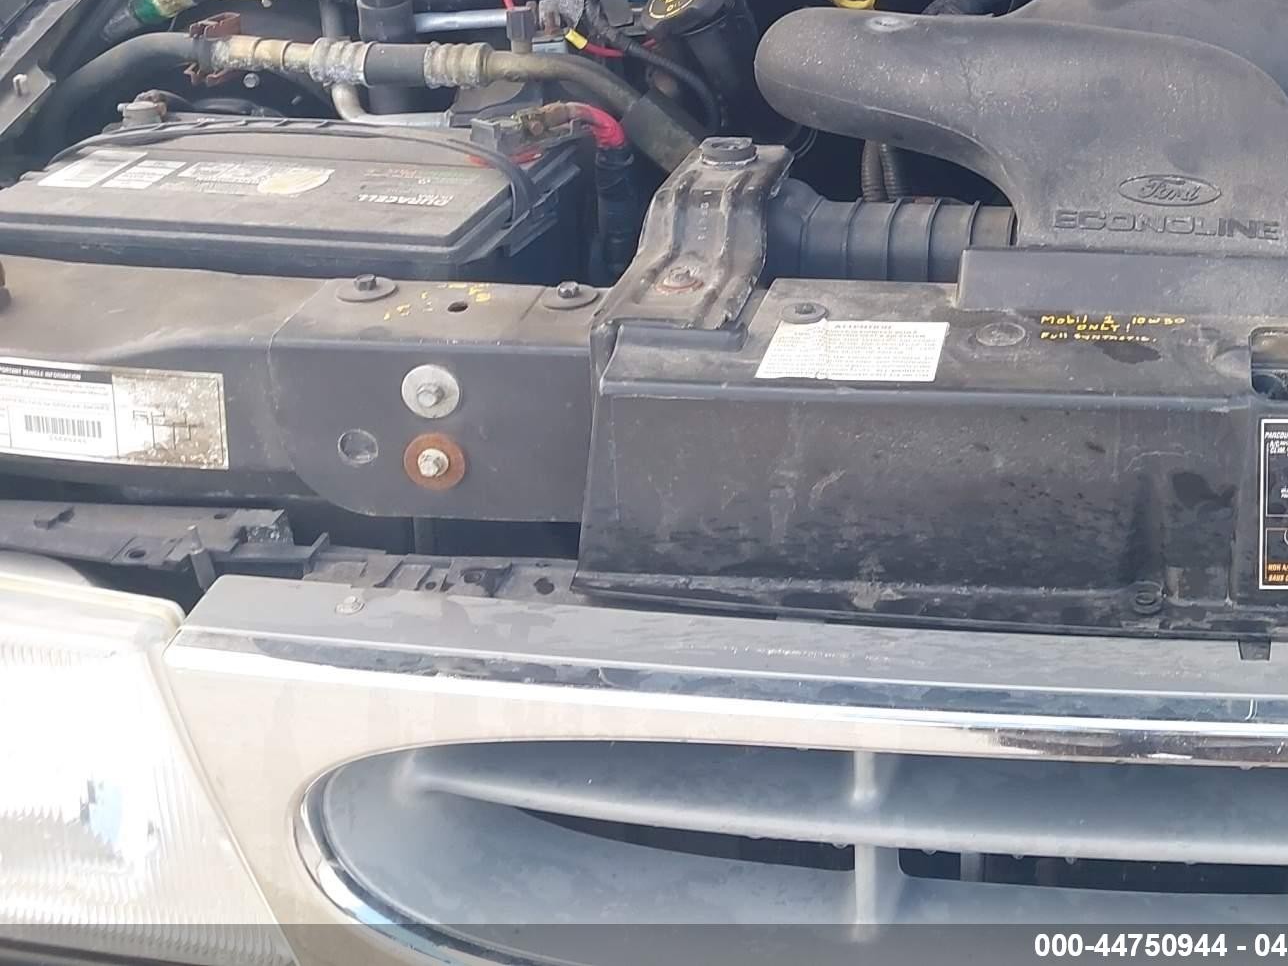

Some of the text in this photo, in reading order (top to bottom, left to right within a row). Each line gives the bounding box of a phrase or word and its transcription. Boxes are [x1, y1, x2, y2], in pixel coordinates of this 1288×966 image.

[1140, 177, 1200, 202] Ford
[358, 193, 454, 207] DURACELL
[1053, 209, 1280, 241] ECONOLINE
[1040, 314, 1088, 326] Mobil
